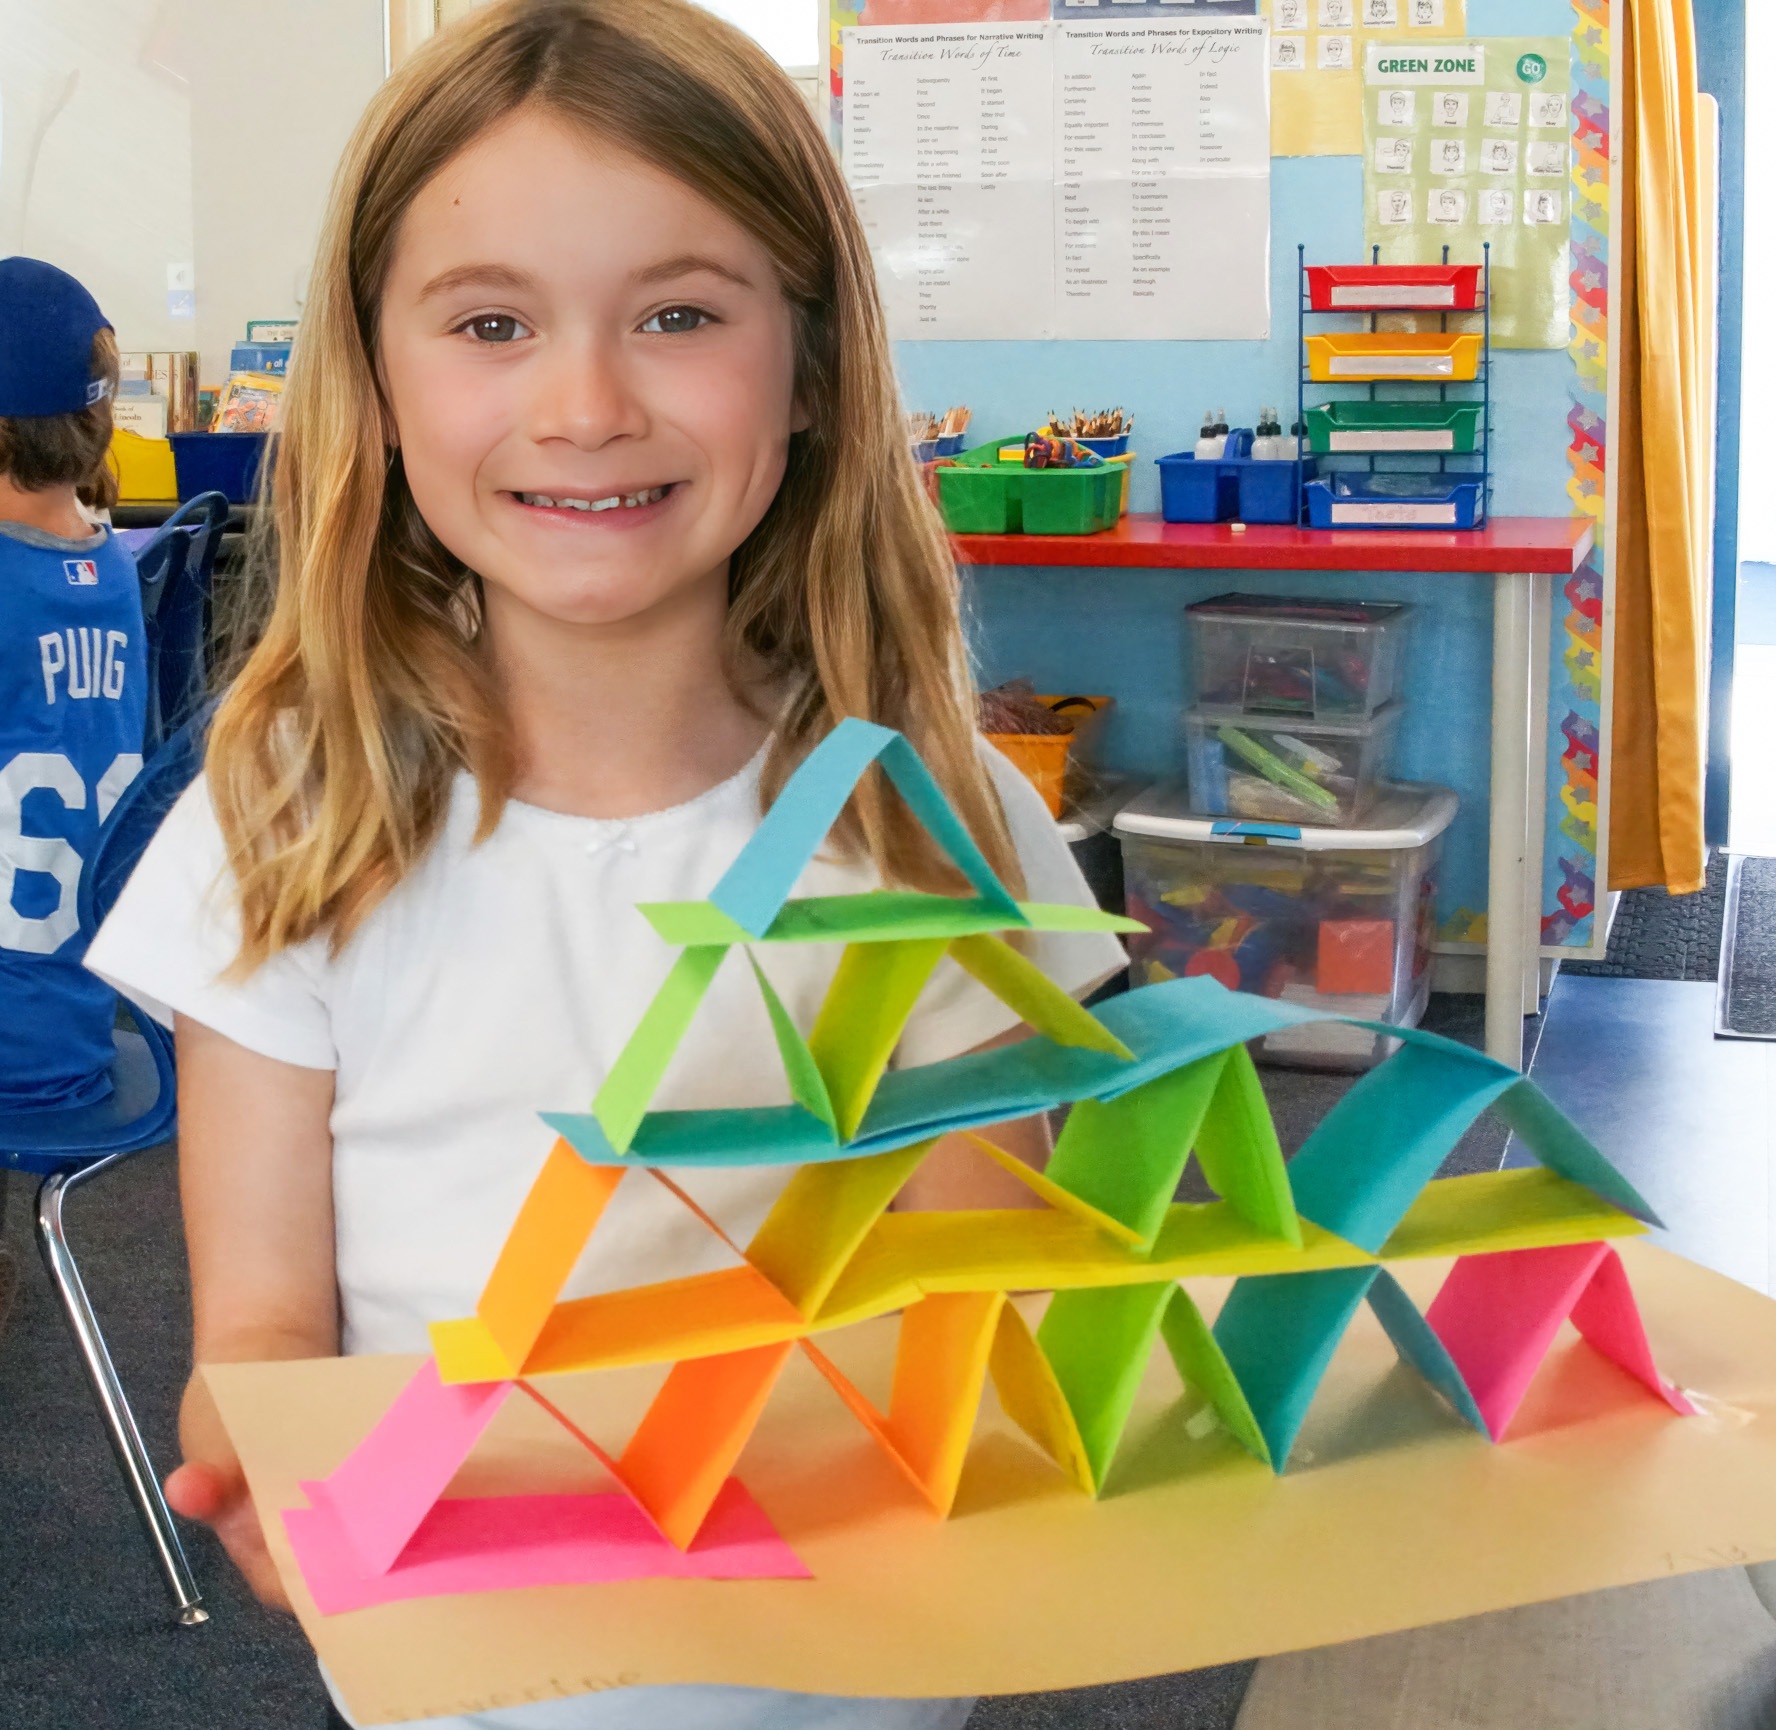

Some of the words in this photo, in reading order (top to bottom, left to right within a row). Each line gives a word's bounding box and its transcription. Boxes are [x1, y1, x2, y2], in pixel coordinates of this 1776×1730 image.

[1017, 33, 1044, 41] Writing
[1192, 28, 1232, 36] Expository
[1234, 28, 1263, 36] Writing
[880, 48, 934, 61] Transition
[940, 43, 978, 60] Words
[972, 41, 998, 70] of
[996, 46, 1022, 58] Time
[1090, 43, 1146, 56] Transition
[1151, 37, 1191, 54] Words
[1184, 36, 1212, 65] of
[1208, 41, 1240, 63] Logic
[1378, 58, 1429, 73] GREEN
[1434, 58, 1476, 73] ZONE
[1521, 61, 1540, 75] GO
[274, 359, 283, 367] all
[38, 627, 128, 705] PUIG
